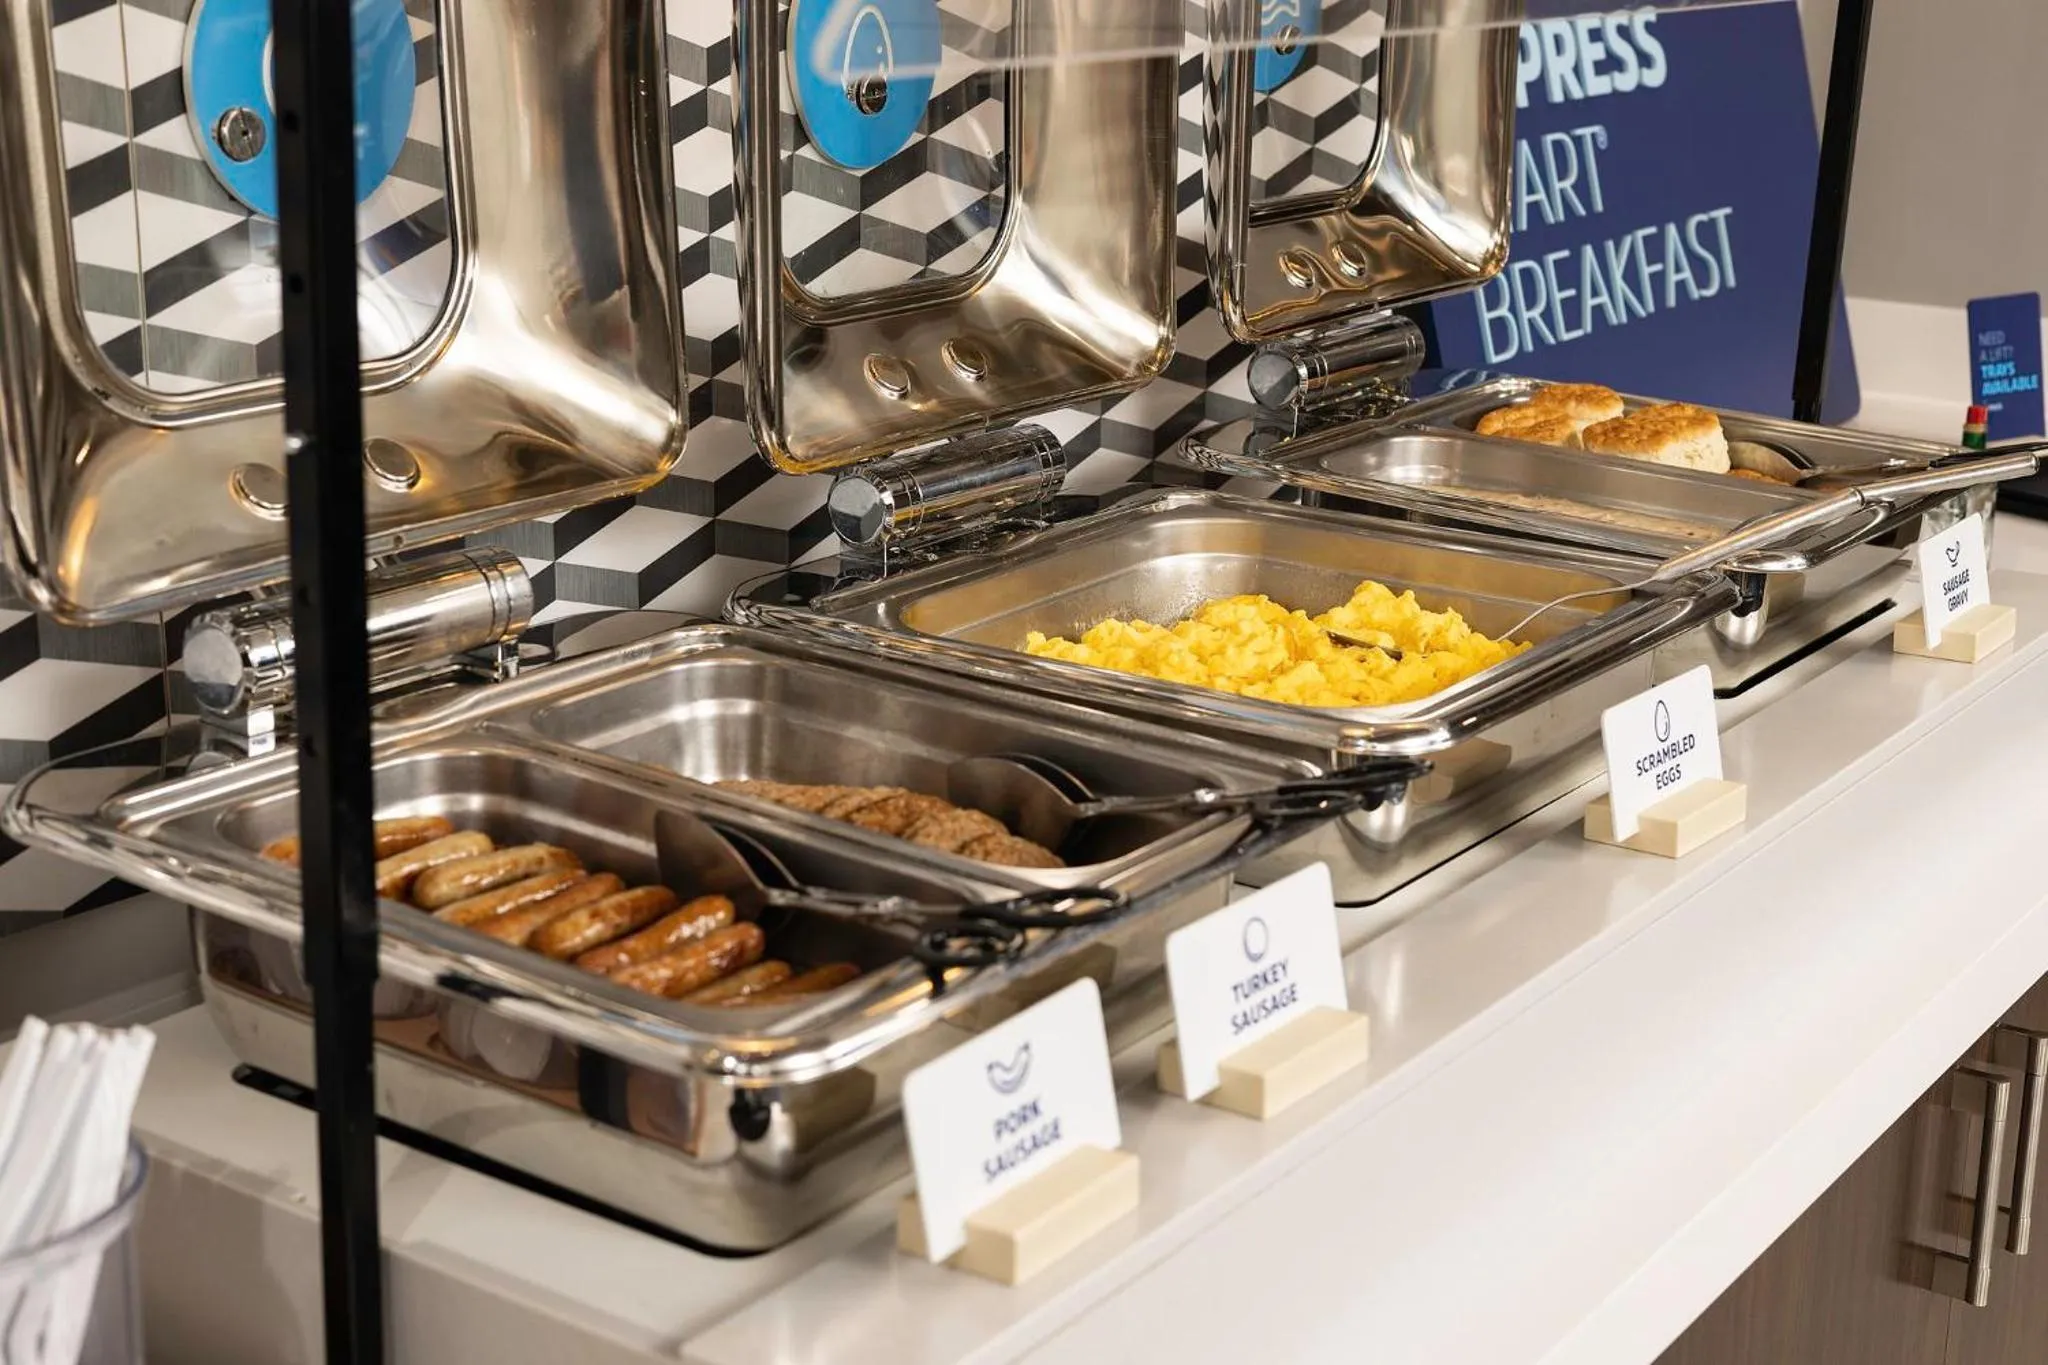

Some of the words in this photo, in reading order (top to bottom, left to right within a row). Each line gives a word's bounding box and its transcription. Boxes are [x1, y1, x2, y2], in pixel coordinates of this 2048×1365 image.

[1510, 125, 1607, 233] ART
[1475, 207, 1736, 364] BREAKFAST
[1978, 330, 2005, 346] NEED
[1981, 362, 2015, 379] TRAYS
[1982, 374, 2038, 396] AVAILABLE
[1943, 569, 1970, 595] SAUSAGE
[1948, 588, 1969, 611] GRAVY
[1636, 734, 1695, 776] SCRAMBLED
[1655, 764, 1682, 790] EGGS
[1231, 958, 1289, 1003] TURKEY
[1231, 983, 1298, 1035] SAUSAGE
[994, 1095, 1042, 1140] PORK
[983, 1117, 1062, 1182] SAUSAGE
